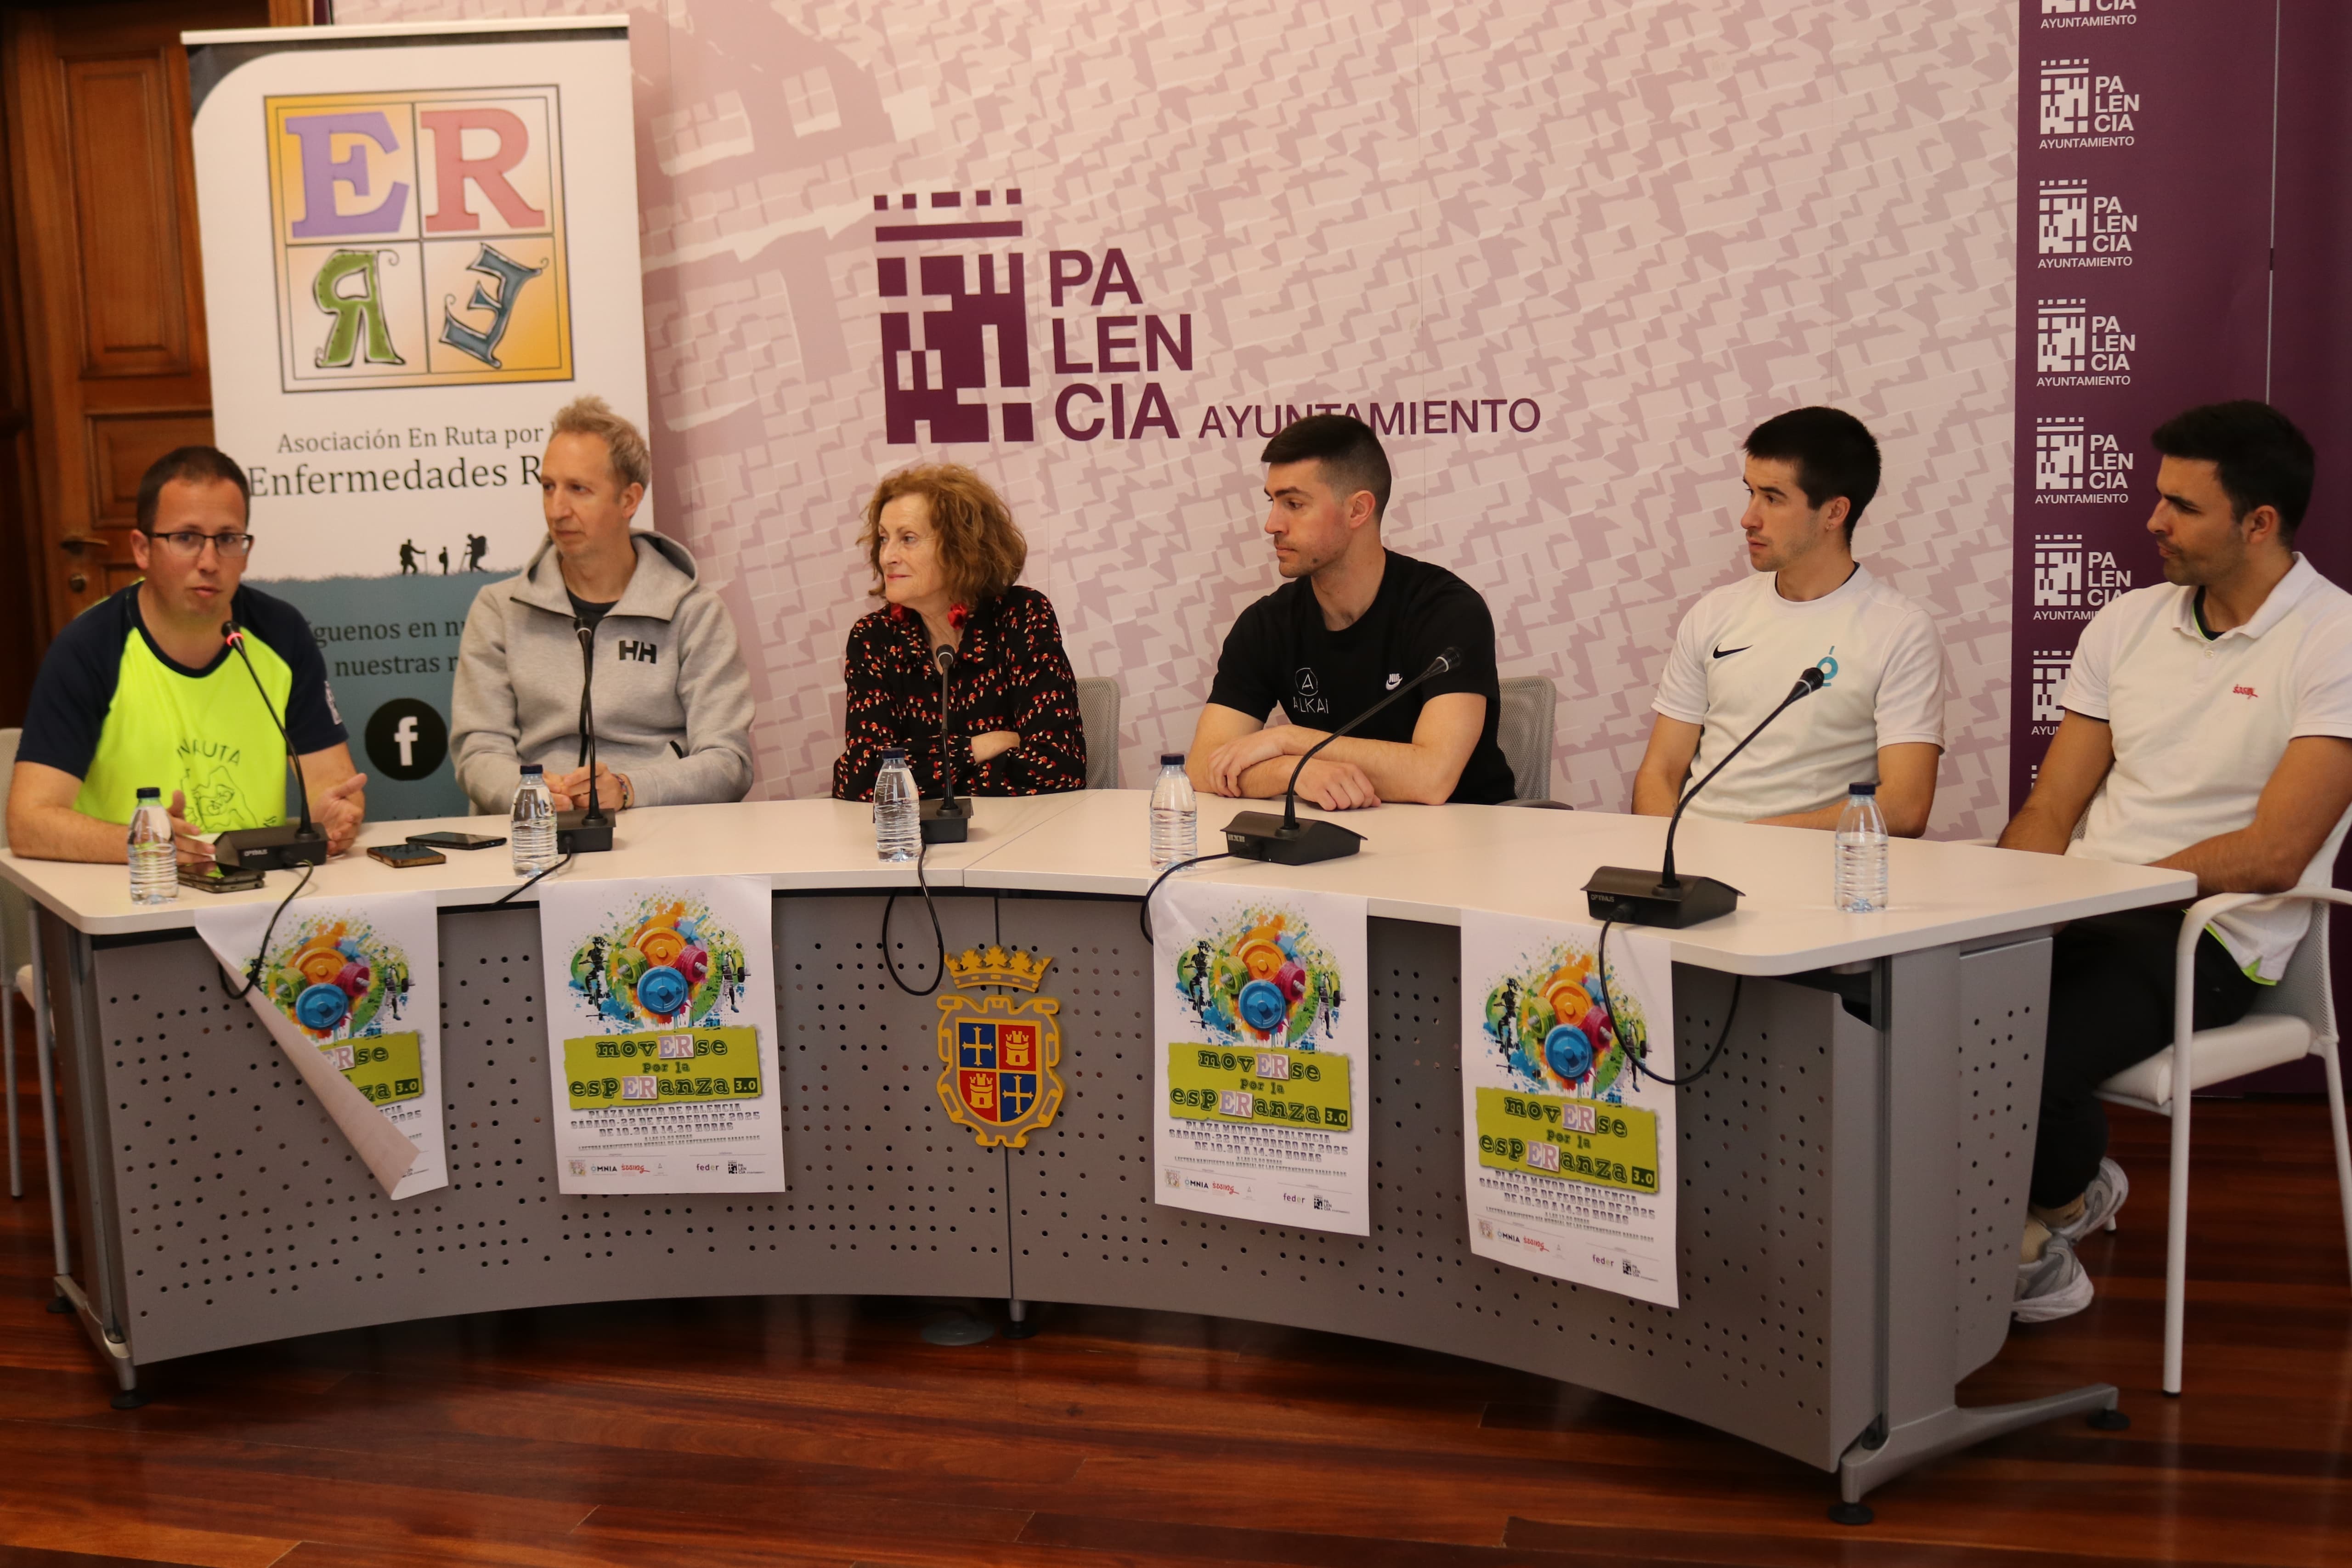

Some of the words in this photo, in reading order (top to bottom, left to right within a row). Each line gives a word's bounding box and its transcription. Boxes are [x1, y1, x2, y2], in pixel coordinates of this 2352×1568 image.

[2041, 15, 2136, 28] AYUNTAMIENTO
[2095, 76, 2125, 93] PA
[2095, 94, 2139, 113] LEN
[2094, 114, 2134, 132] CIA
[2039, 136, 2134, 149] AYUNTAMIENTO
[2094, 196, 2123, 214] PA
[2093, 215, 2137, 233] LEN
[2092, 235, 2132, 252] CIA
[2038, 256, 2132, 268] AYUNTAMIENTO
[1049, 248, 1143, 307] PA
[2092, 316, 2121, 333] PA
[1052, 313, 1193, 374] LEN
[2092, 334, 2136, 352] LEN
[2091, 354, 2131, 371] CIA
[2036, 375, 2131, 386] AYUNTAMIENTO
[1055, 382, 1181, 442] CIA
[277, 429, 401, 454] Asociación
[408, 428, 437, 448] En
[445, 425, 497, 446] Ruta
[504, 427, 543, 449] por
[2090, 434, 2119, 451] PA
[2090, 453, 2133, 470] LEN
[248, 457, 507, 497] Enfermedades
[2089, 472, 2128, 489] CIA
[2035, 493, 2128, 504] AYUNTAMIENTO
[2088, 552, 2117, 568] PA
[2088, 571, 2131, 587] LEN
[313, 623, 401, 649] guenos
[408, 622, 437, 638] en
[619, 640, 657, 664] HH
[334, 656, 440, 677] nuestras
[1293, 696, 1329, 713] ALKAI
[394, 716, 418, 766] f
[1591, 894, 1614, 902] OPTIMUS
[642, 1062, 668, 1073] por
[676, 1061, 690, 1073] la
[396, 1081, 418, 1093] 3.0
[735, 1080, 757, 1091] 3.0
[1240, 1078, 1265, 1091] por
[1271, 1082, 1284, 1095] la
[391, 1110, 422, 1123] 2025
[588, 1109, 625, 1119] PLAZA
[628, 1107, 665, 1117] MAYOR
[668, 1106, 683, 1115] DE
[685, 1103, 741, 1114] PALENCIA
[639, 1117, 653, 1126] DE
[656, 1114, 708, 1124] FEBRERO
[712, 1113, 726, 1122] DE
[729, 1111, 760, 1121] 2025
[1326, 1110, 1346, 1123] 3.0
[599, 1128, 614, 1137] DE
[616, 1126, 648, 1136] 10.30
[661, 1124, 692, 1134] 14.30
[695, 1122, 734, 1132] HORAS
[1186, 1121, 1220, 1132] PLAZA
[1222, 1124, 1259, 1136] MAYOR
[1261, 1128, 1275, 1138] DE
[1278, 1130, 1330, 1143] PALENCIA
[1233, 1135, 1246, 1145] DE
[1250, 1137, 1298, 1150] FEBRERO
[1301, 1142, 1315, 1152] DE
[1318, 1144, 1348, 1155] 2025
[1546, 1129, 1570, 1143] por
[1577, 1135, 1591, 1149] la
[1194, 1141, 1208, 1150] DE
[1210, 1143, 1241, 1154] 10.30
[1244, 1146, 1250, 1155] A
[1253, 1147, 1283, 1158] 14.30
[1285, 1150, 1322, 1162] HORAS
[1633, 1170, 1654, 1185] 3.0
[1495, 1171, 1528, 1185] PLAZA
[1531, 1177, 1565, 1192] MAYOR
[1568, 1184, 1582, 1194] DE
[1584, 1187, 1637, 1206] PALENCIA
[1283, 1193, 1305, 1204] feder
[1541, 1189, 1555, 1200] DE
[1556, 1192, 1606, 1210] FEBRERO
[1608, 1202, 1622, 1213] DE
[1625, 1205, 1655, 1219] 2025
[1504, 1192, 1517, 1204] DE
[1520, 1195, 1549, 1209] 10.30
[1551, 1201, 1558, 1211] A
[1561, 1203, 1589, 1217] 14.30
[1592, 1209, 1629, 1225] HORAS
[1593, 1254, 1614, 1267] feder
